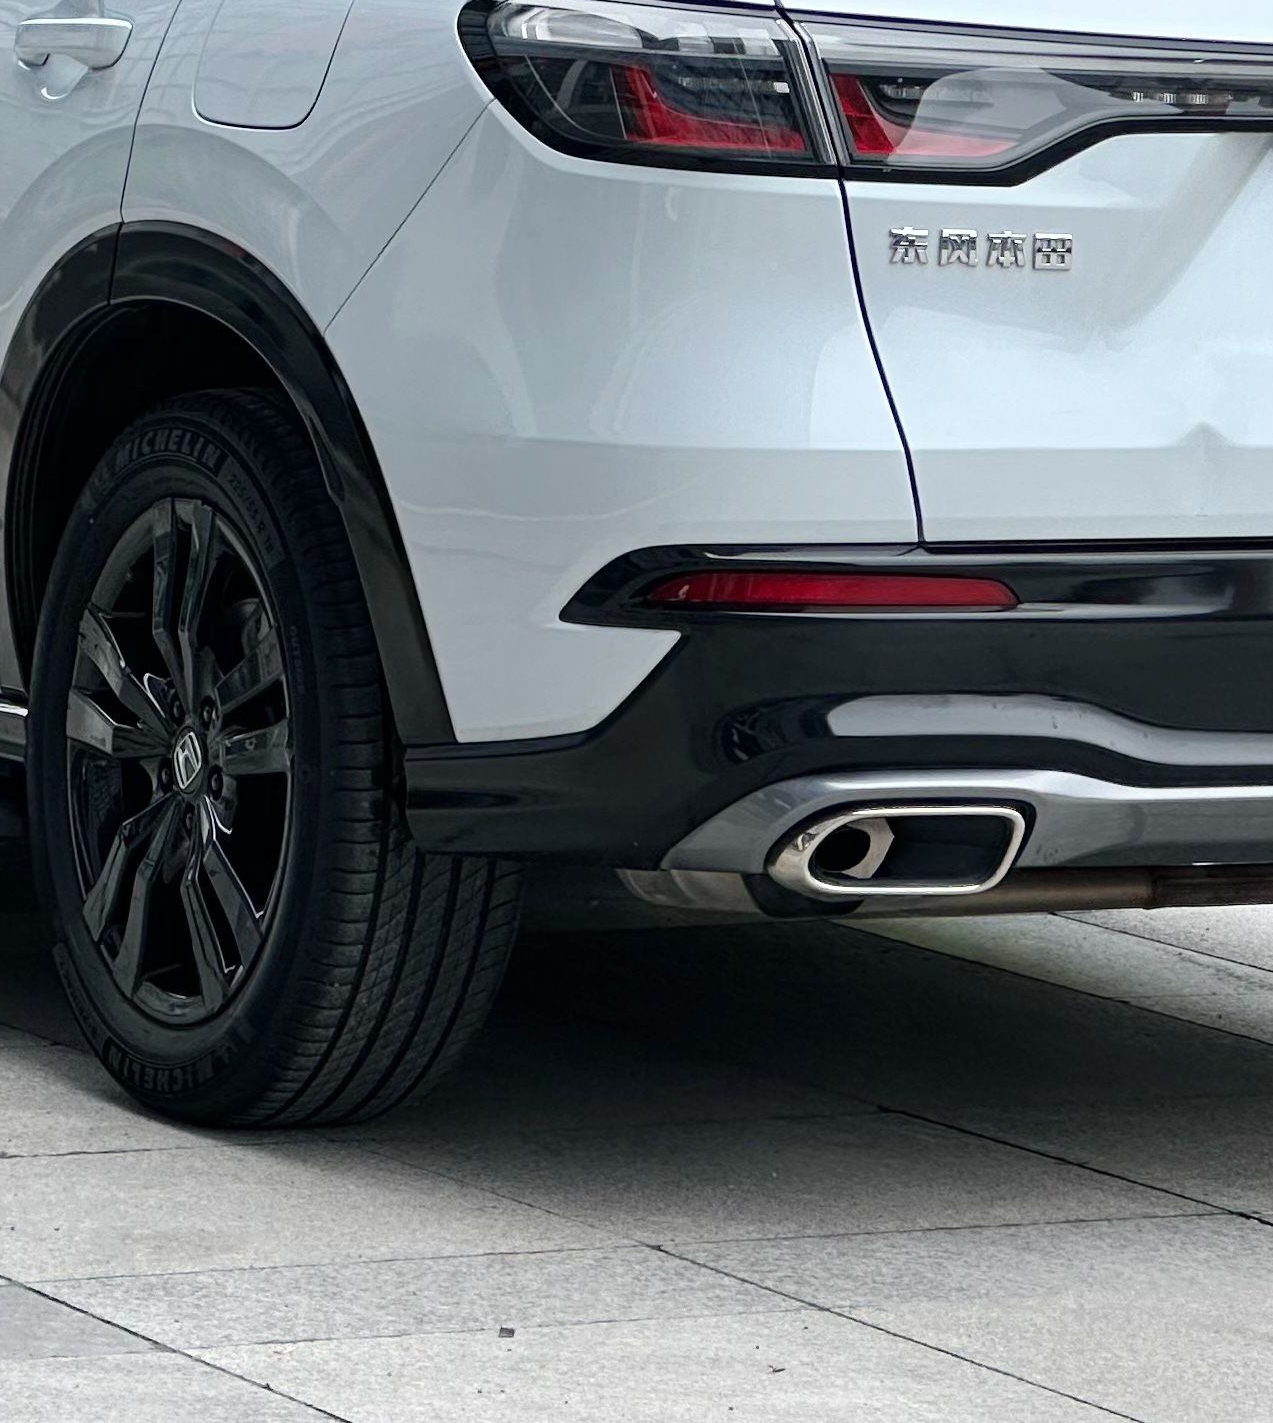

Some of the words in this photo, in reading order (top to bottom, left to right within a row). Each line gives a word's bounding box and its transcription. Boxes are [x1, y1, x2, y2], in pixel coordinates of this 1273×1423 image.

[889, 226, 1073, 270] 东风本田
[117, 428, 222, 470] MICHELIN
[108, 1047, 215, 1092] MICHELIN
